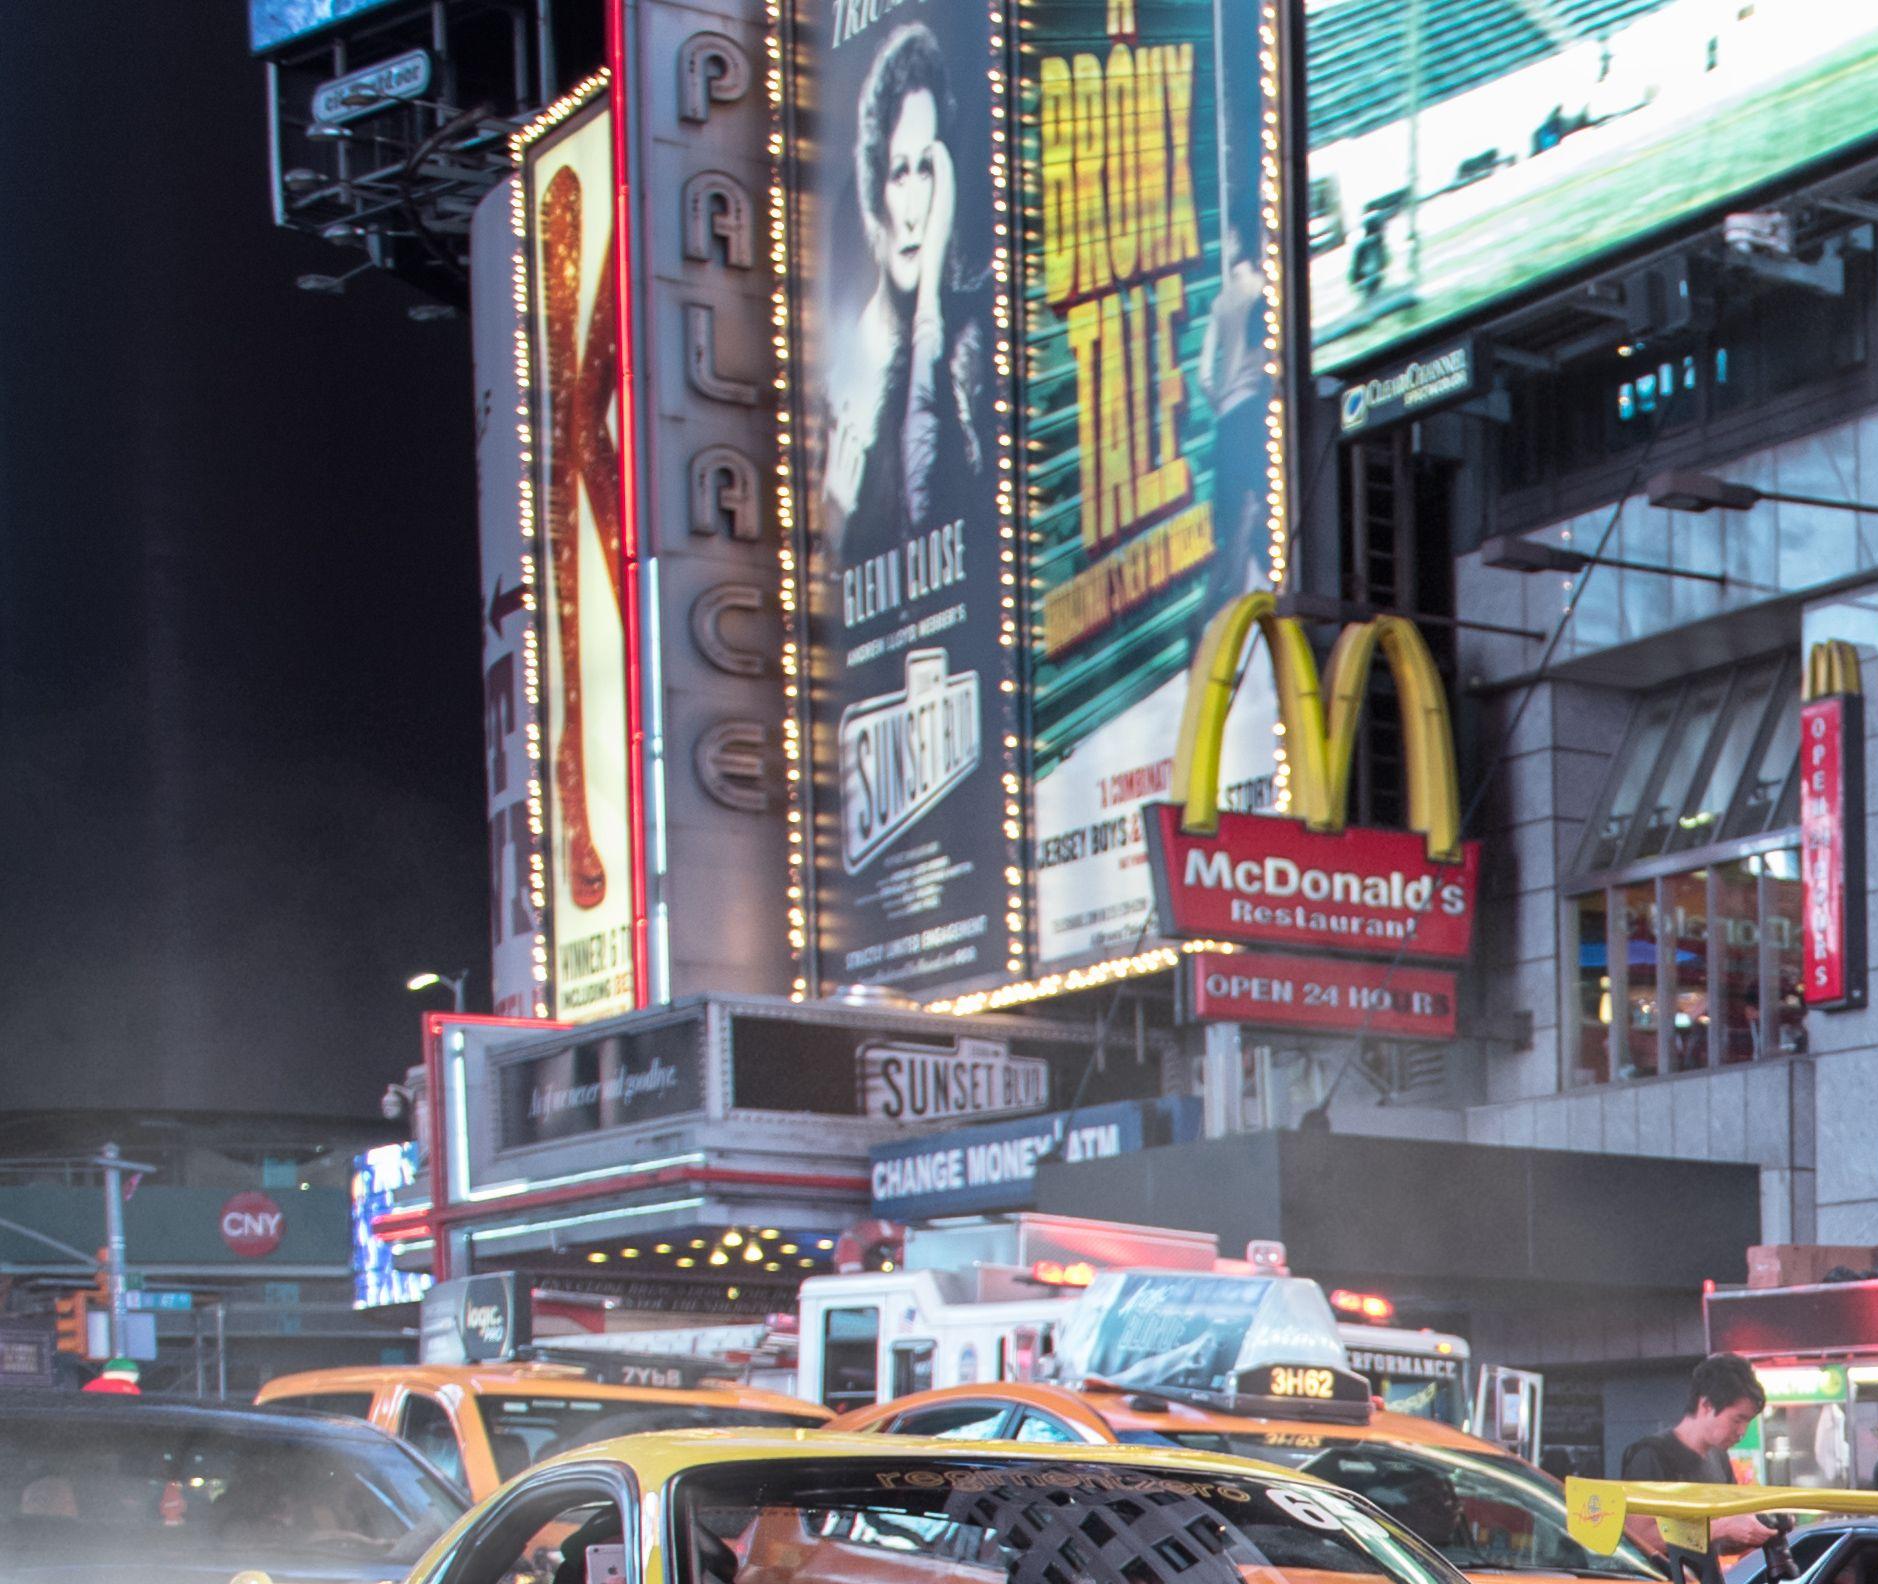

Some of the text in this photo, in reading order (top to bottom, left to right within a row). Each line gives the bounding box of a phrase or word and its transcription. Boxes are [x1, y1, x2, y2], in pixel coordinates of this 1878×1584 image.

[1039, 42, 1199, 305] BRONX
[1068, 272, 1189, 549] TALE
[907, 518, 967, 600] CLOSE
[1183, 847, 1467, 916] McDonald's
[1230, 898, 1418, 940] Restaurant
[1205, 973, 1294, 1003] OPEN
[1302, 981, 1340, 1008] 24
[880, 1055, 997, 1118] SUNSET
[871, 1122, 1121, 1201] CHANGE MONEY ATM
[221, 1210, 284, 1239] CNY
[1269, 1366, 1335, 1399] 3H62
